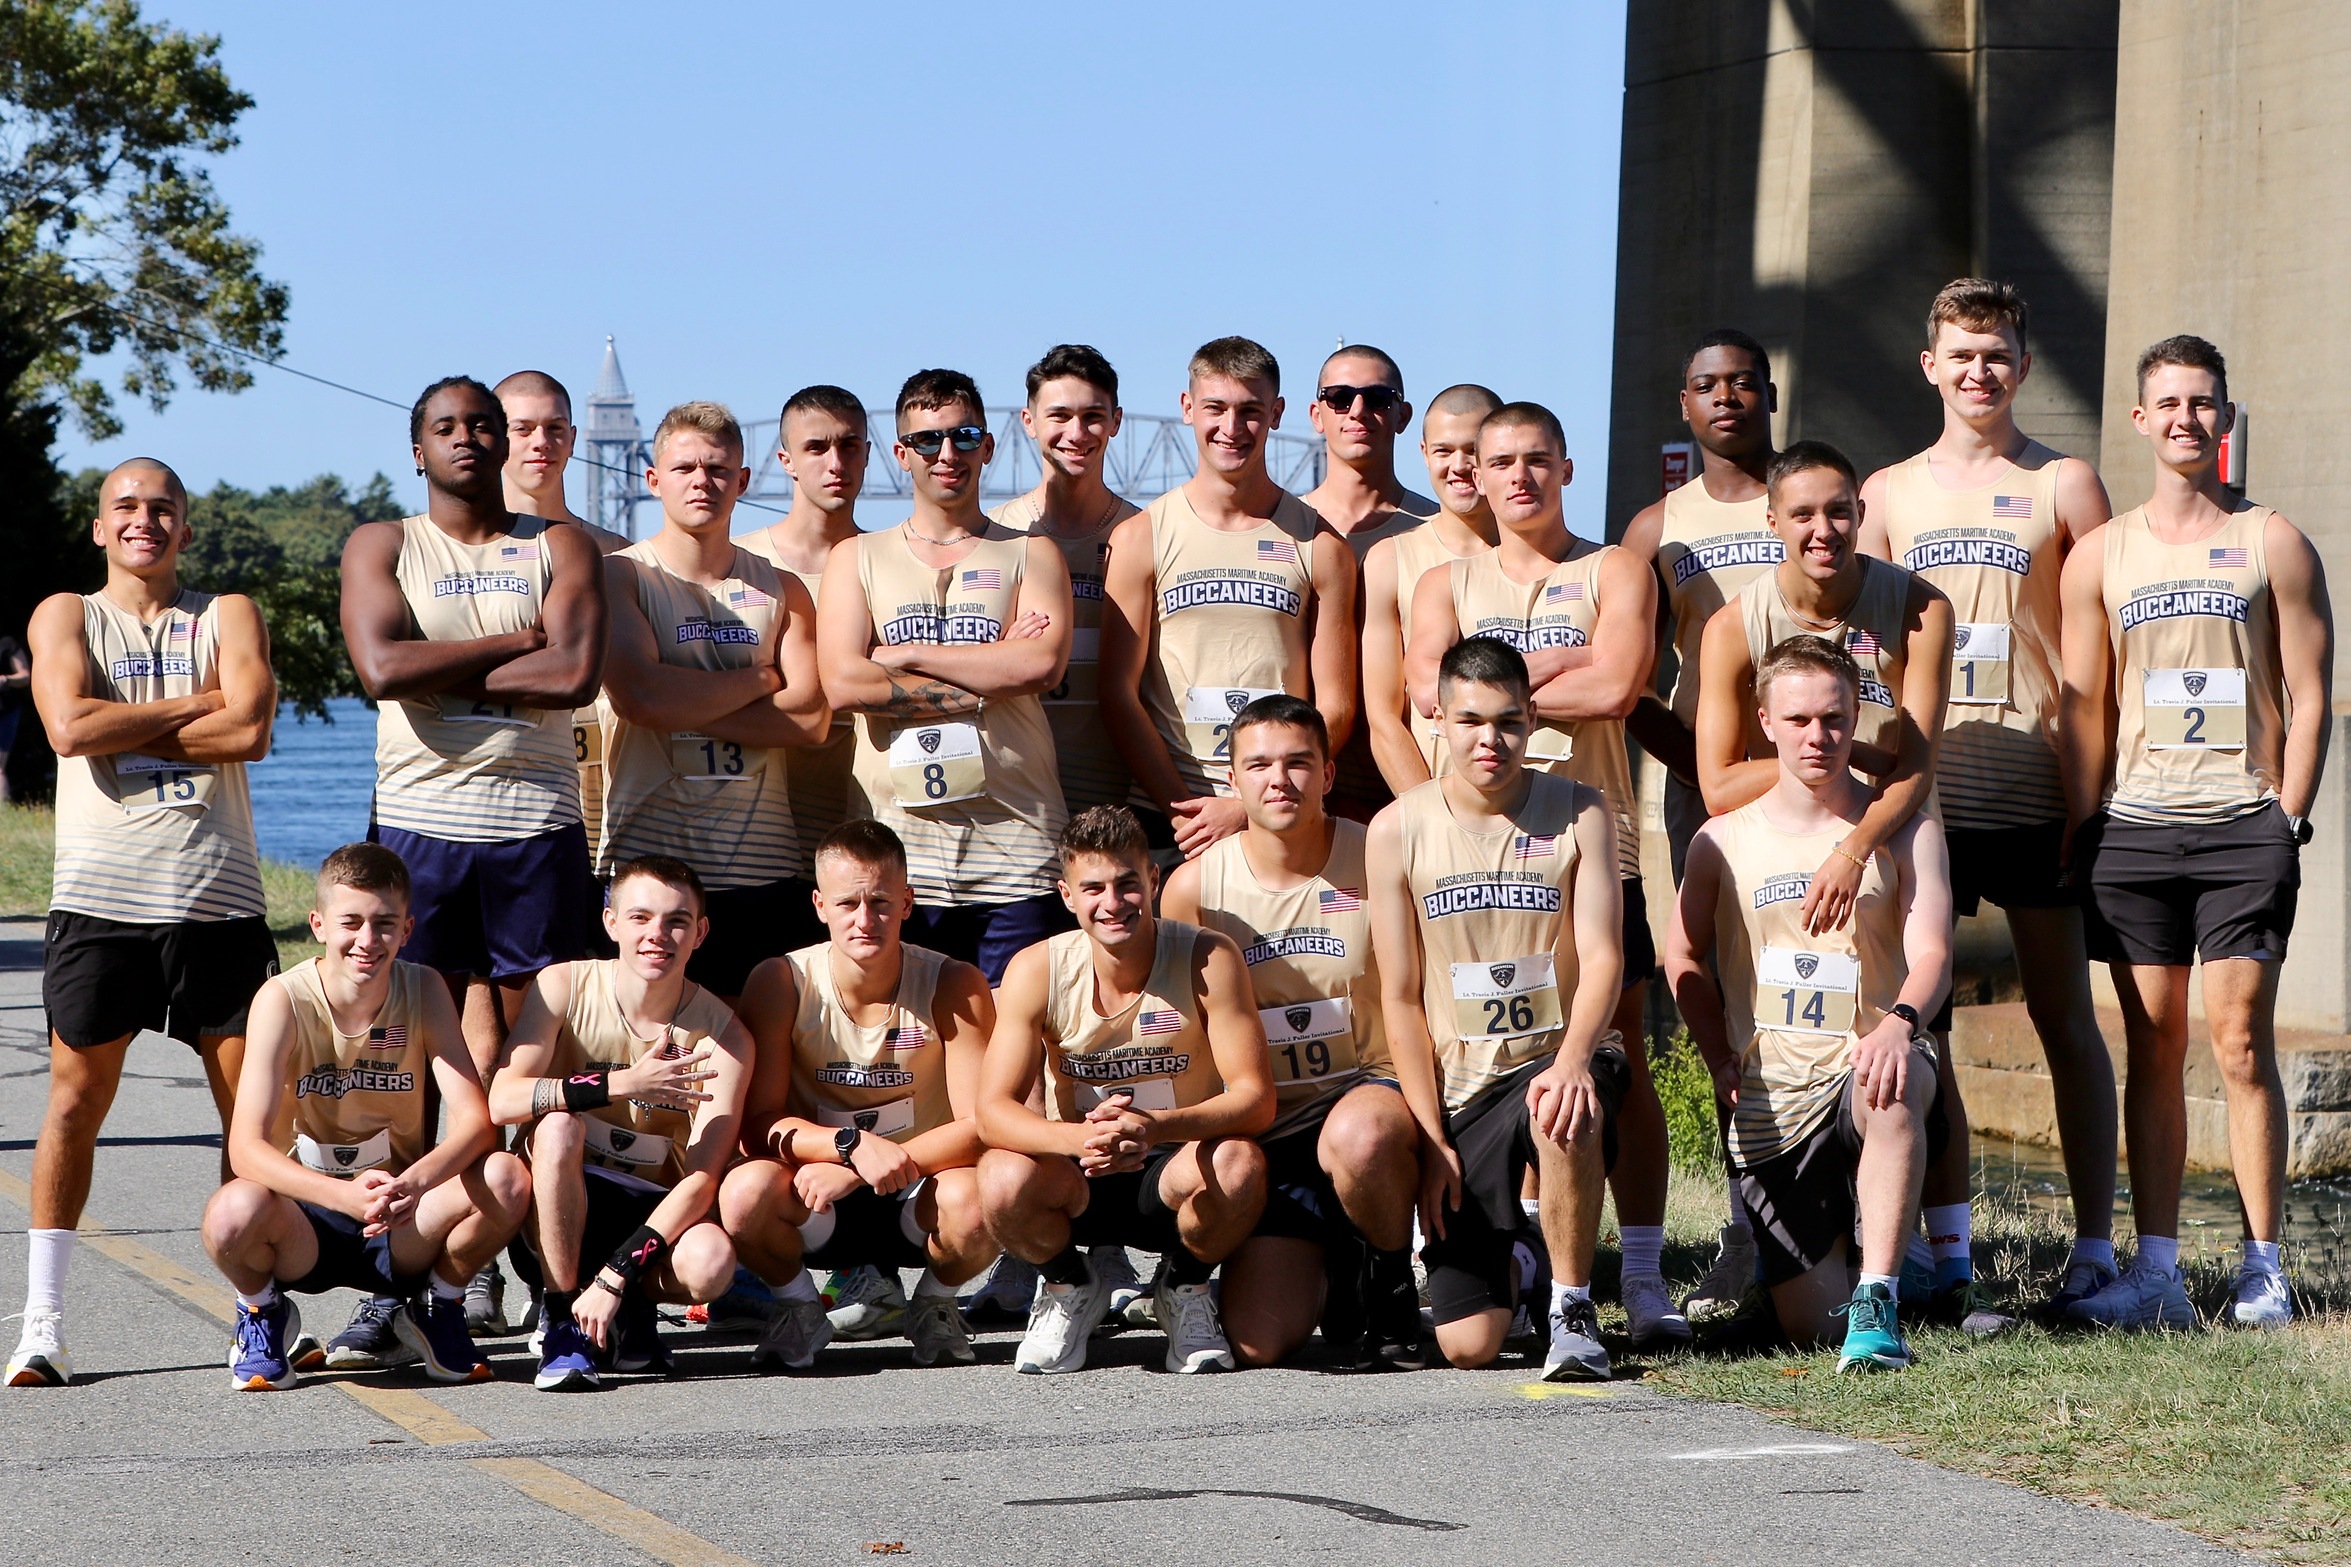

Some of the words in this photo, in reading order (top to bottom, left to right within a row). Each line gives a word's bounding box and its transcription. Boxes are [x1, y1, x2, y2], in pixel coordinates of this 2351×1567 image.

[1735, 531, 1763, 540] MARITIME
[1914, 528, 1959, 544] MASSACHUSETTS
[1961, 528, 1988, 538] MARITIME
[1990, 529, 2016, 543] ACADEMY
[1673, 541, 1786, 587] BUCCANEE
[1904, 540, 2030, 576] BUCCANEERS
[434, 577, 529, 597] BUCCANEERS
[1177, 568, 1226, 584] MASSACHUSETTS
[1228, 568, 1257, 579] MARITIME
[1259, 571, 1286, 586] ACADEMY
[2131, 580, 2177, 599] MASSACHUSETTS
[2179, 579, 2206, 590] MARITIME
[2207, 579, 2234, 592] ACADEMY
[959, 603, 985, 614] ACADEMY
[1163, 580, 1300, 617] BUCCANEERS
[2119, 591, 2249, 632] BUCCANEERS
[1544, 614, 1571, 624] ACADEMY
[676, 622, 759, 646] BUCCNEERS
[1960, 661, 1974, 696] 1
[2183, 707, 2205, 743] 2
[700, 740, 744, 775] 13
[941, 751, 973, 760] Invitational
[148, 771, 195, 802] 15
[924, 764, 947, 799] 8
[1435, 872, 1486, 890] MASSACHUSETTS
[1516, 871, 1544, 883] ACADEMY
[1423, 884, 1561, 920] BUCCANEERS
[1242, 935, 1345, 967] BUCCANEERS
[1515, 982, 1548, 993] Invitational
[1483, 996, 1534, 1034] 26
[1781, 989, 1825, 1028] 14
[1311, 1028, 1345, 1039] Invitational
[1112, 1047, 1143, 1059] MARITIME
[1144, 1046, 1174, 1057] ACADEMY
[1281, 1041, 1330, 1079] 19
[371, 1059, 398, 1073] ACADEMY
[816, 1069, 913, 1088] BUCCANEERS
[1058, 1054, 1190, 1080] BUCCANEERS
[296, 1070, 414, 1099] BUCCANEERS
